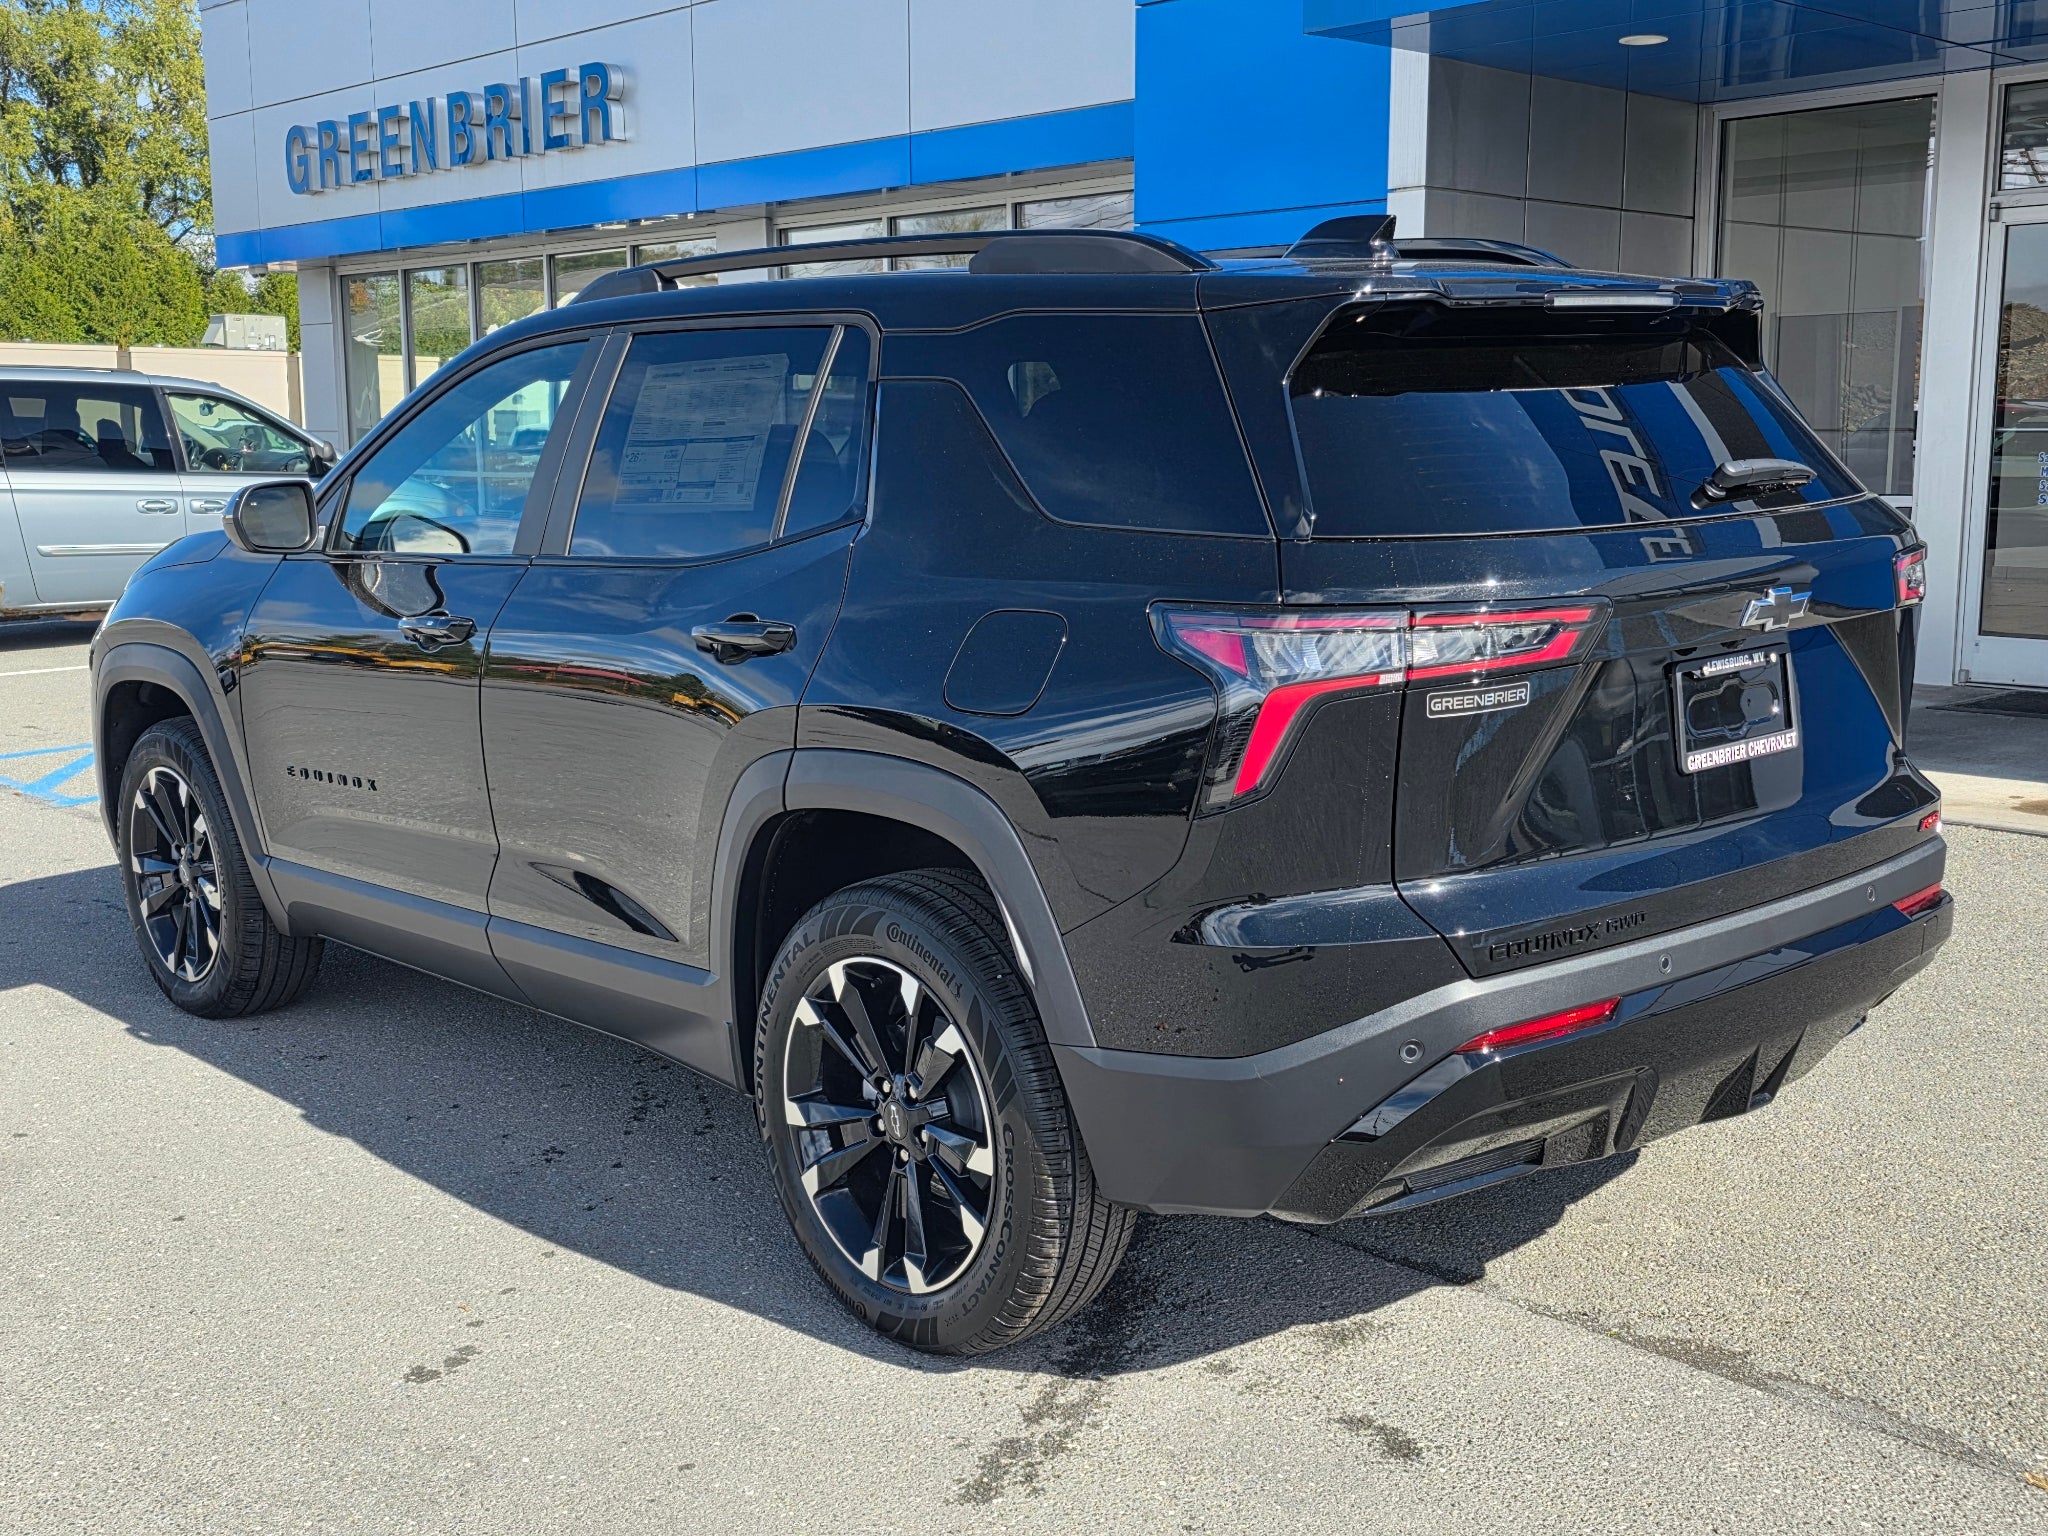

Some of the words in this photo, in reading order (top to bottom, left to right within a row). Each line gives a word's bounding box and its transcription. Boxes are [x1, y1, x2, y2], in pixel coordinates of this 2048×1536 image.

[286, 61, 626, 195] GREENBRIER
[1707, 654, 1752, 672] LEWISBURG,
[1752, 652, 1765, 664] WV
[1431, 688, 1526, 711] GREENBRIER
[1687, 746, 1747, 771] GREENBRIER
[1748, 732, 1797, 757] CHEVROLET
[886, 921, 957, 989] Continental
[1488, 921, 1601, 961] EQUINOX
[756, 931, 816, 1129] CONTINENTAL
[961, 1122, 1015, 1317] CROSSCONTACT
